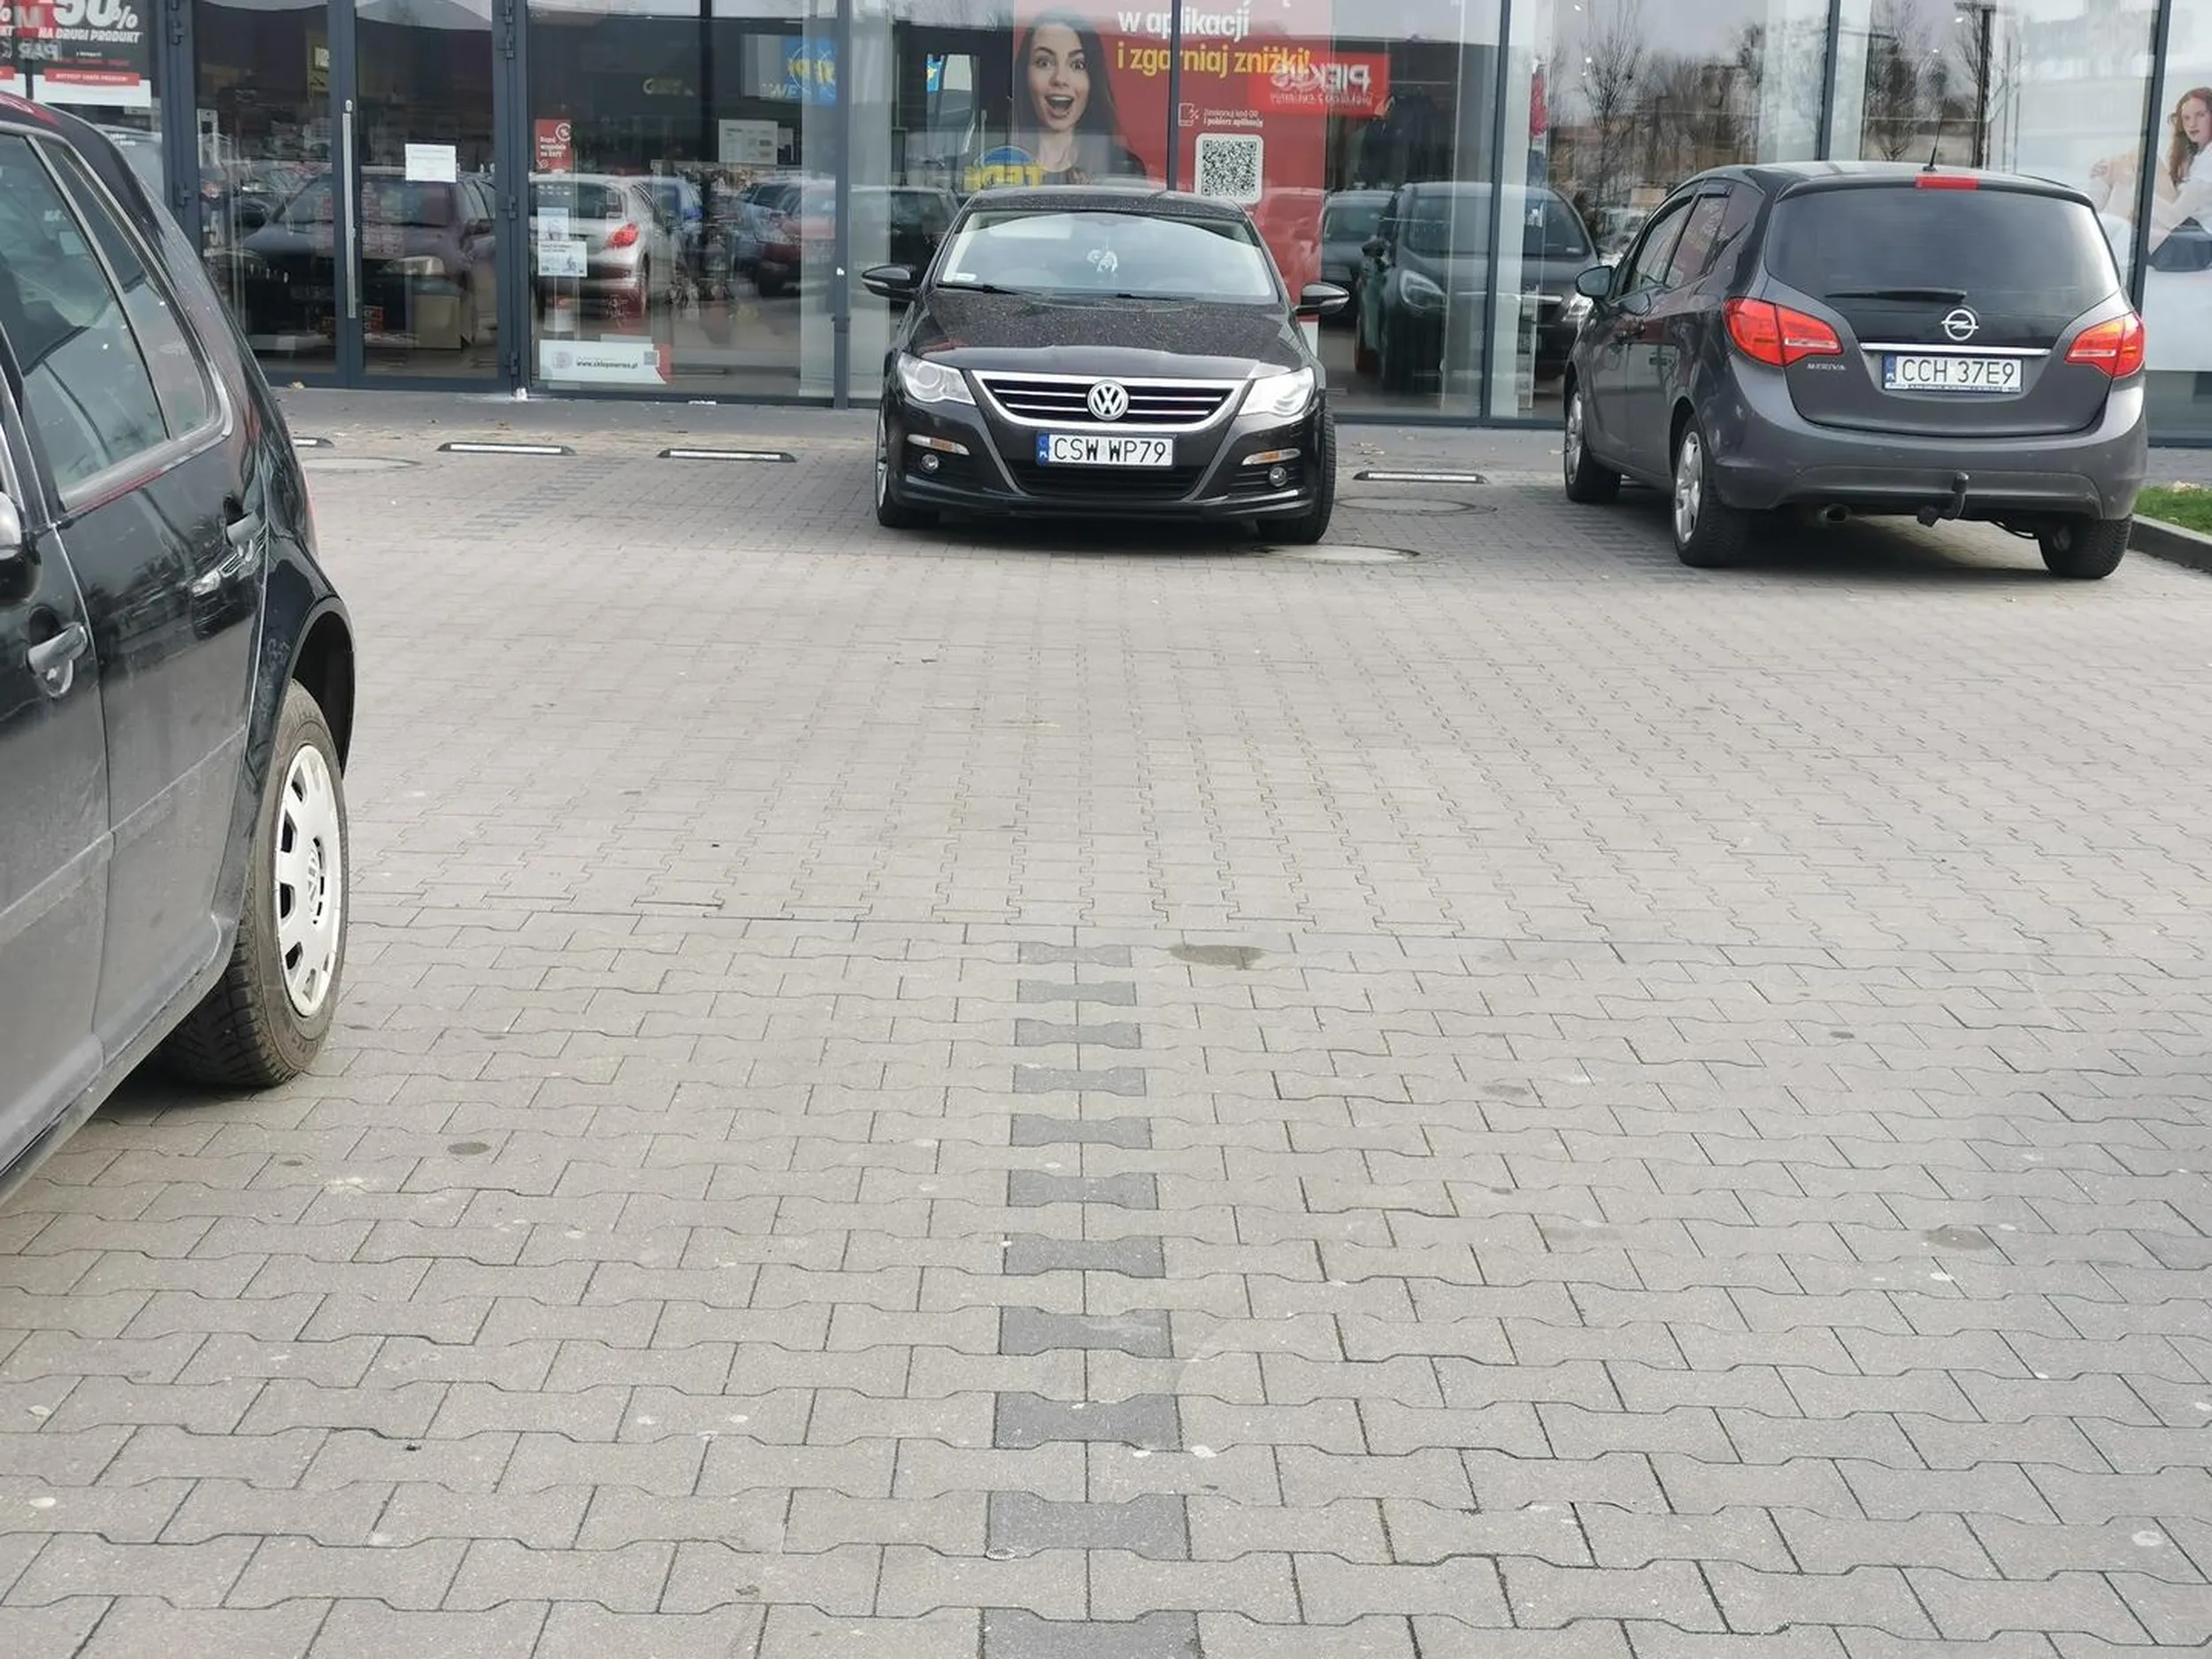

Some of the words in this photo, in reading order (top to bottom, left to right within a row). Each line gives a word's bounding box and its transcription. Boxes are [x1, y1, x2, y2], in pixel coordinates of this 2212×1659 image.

[38, 27, 54, 39] NA
[56, 28, 88, 42] DRUGI
[1118, 12, 1141, 33] w
[1118, 41, 1125, 69] i
[1130, 44, 1228, 79] zganiaj
[1902, 358, 1947, 382] CCH
[1957, 360, 2015, 385] 37E9
[1055, 438, 1099, 461] CSW
[1109, 440, 1166, 464] WP79
